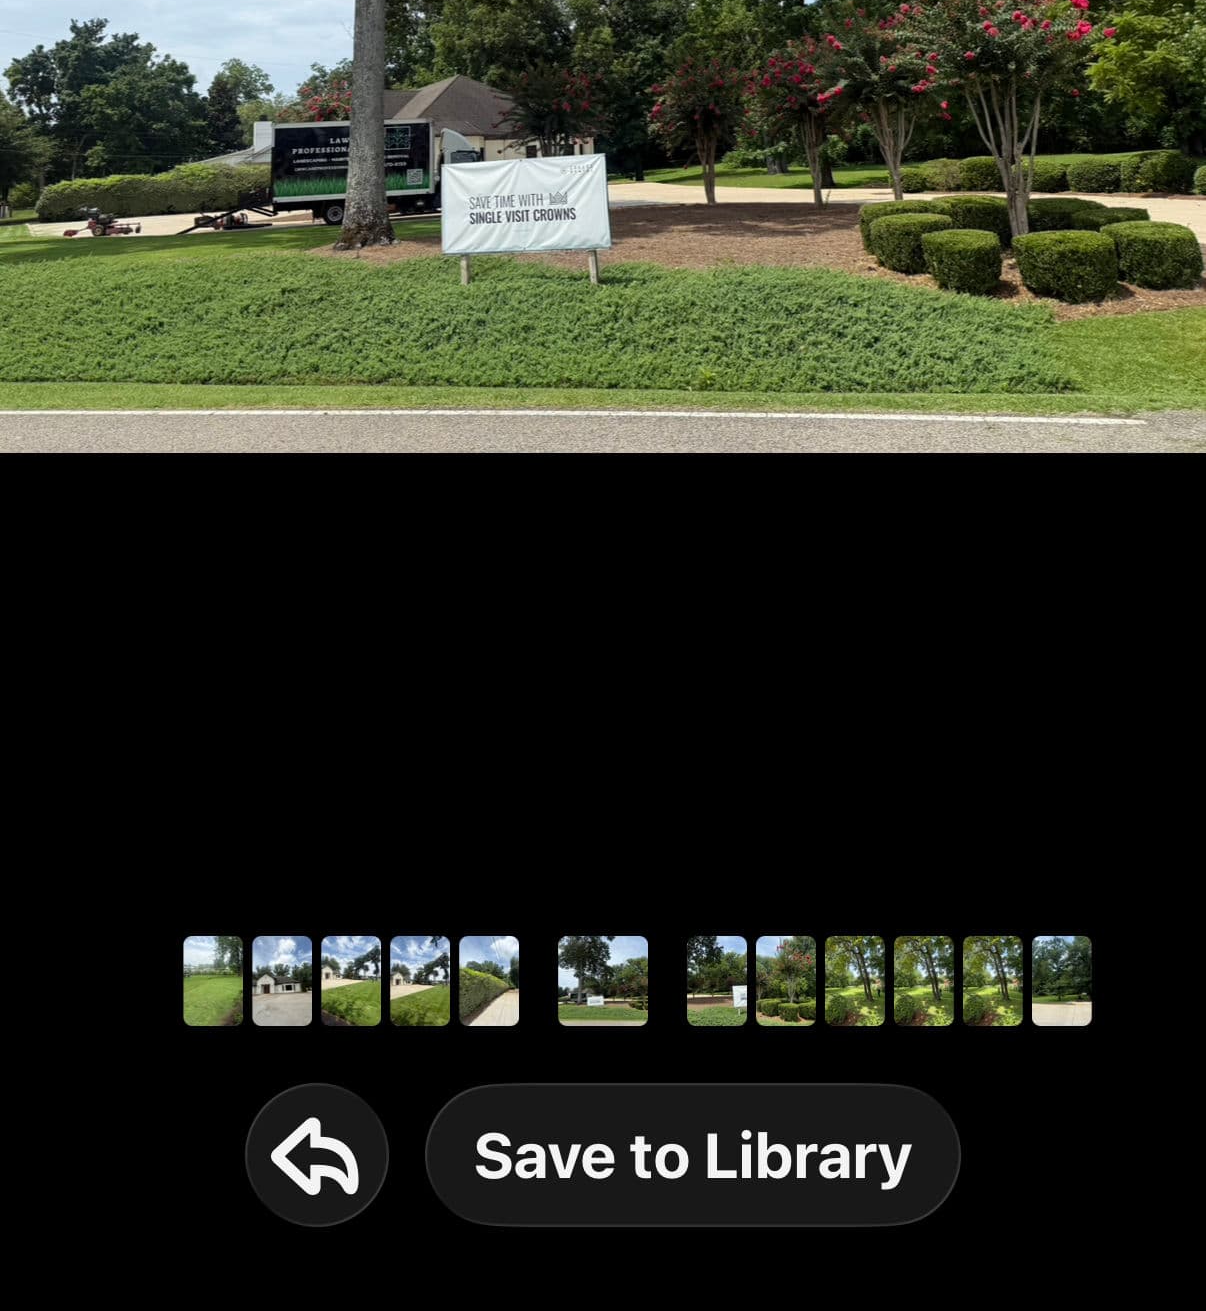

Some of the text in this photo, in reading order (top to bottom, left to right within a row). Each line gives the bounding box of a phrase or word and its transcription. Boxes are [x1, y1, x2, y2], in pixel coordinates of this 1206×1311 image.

[469, 192, 544, 210] SAVE TIME WITH
[469, 207, 577, 225] SINGLE VISIT CROWNS
